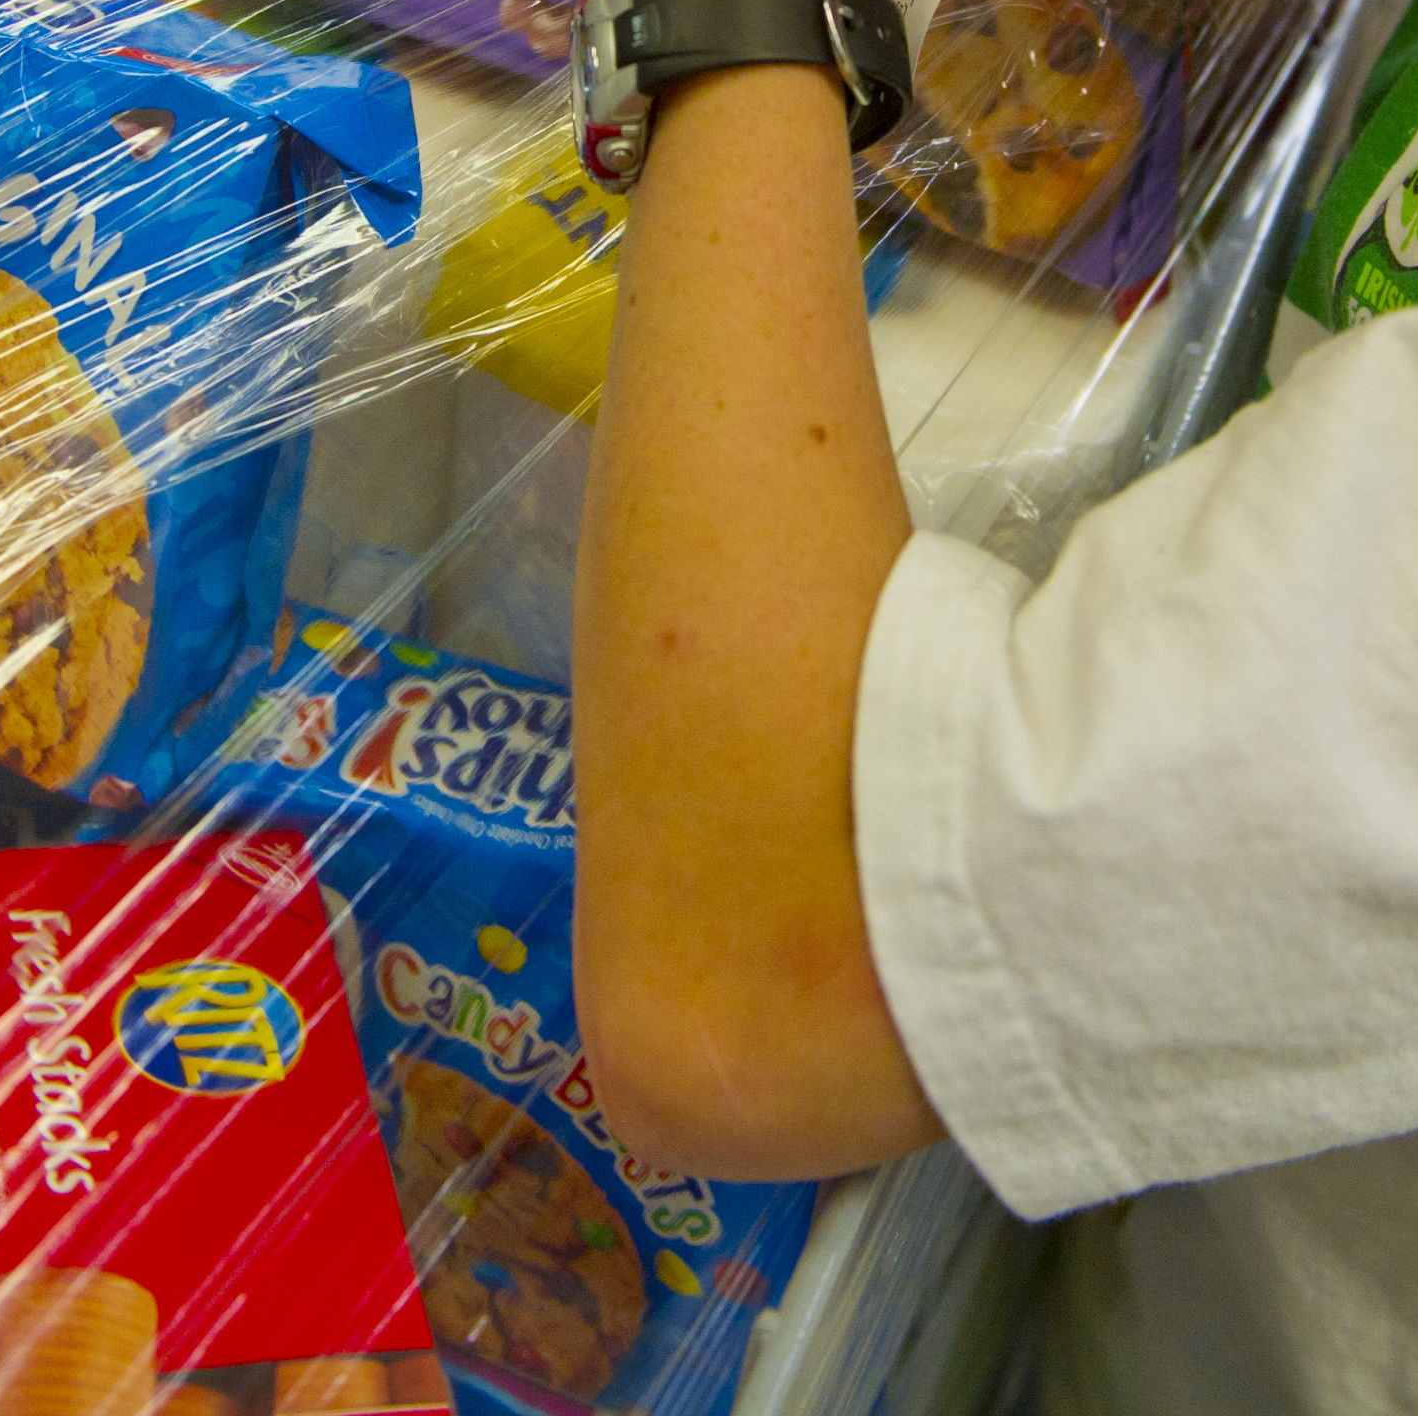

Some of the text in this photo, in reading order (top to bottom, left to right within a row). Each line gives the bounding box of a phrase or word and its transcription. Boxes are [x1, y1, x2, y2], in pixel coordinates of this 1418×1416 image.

[8, 908, 87, 1024] Fresh
[133, 964, 289, 1086] RITZ
[379, 946, 559, 1077] Candy
[25, 1033, 112, 1197] Stacks
